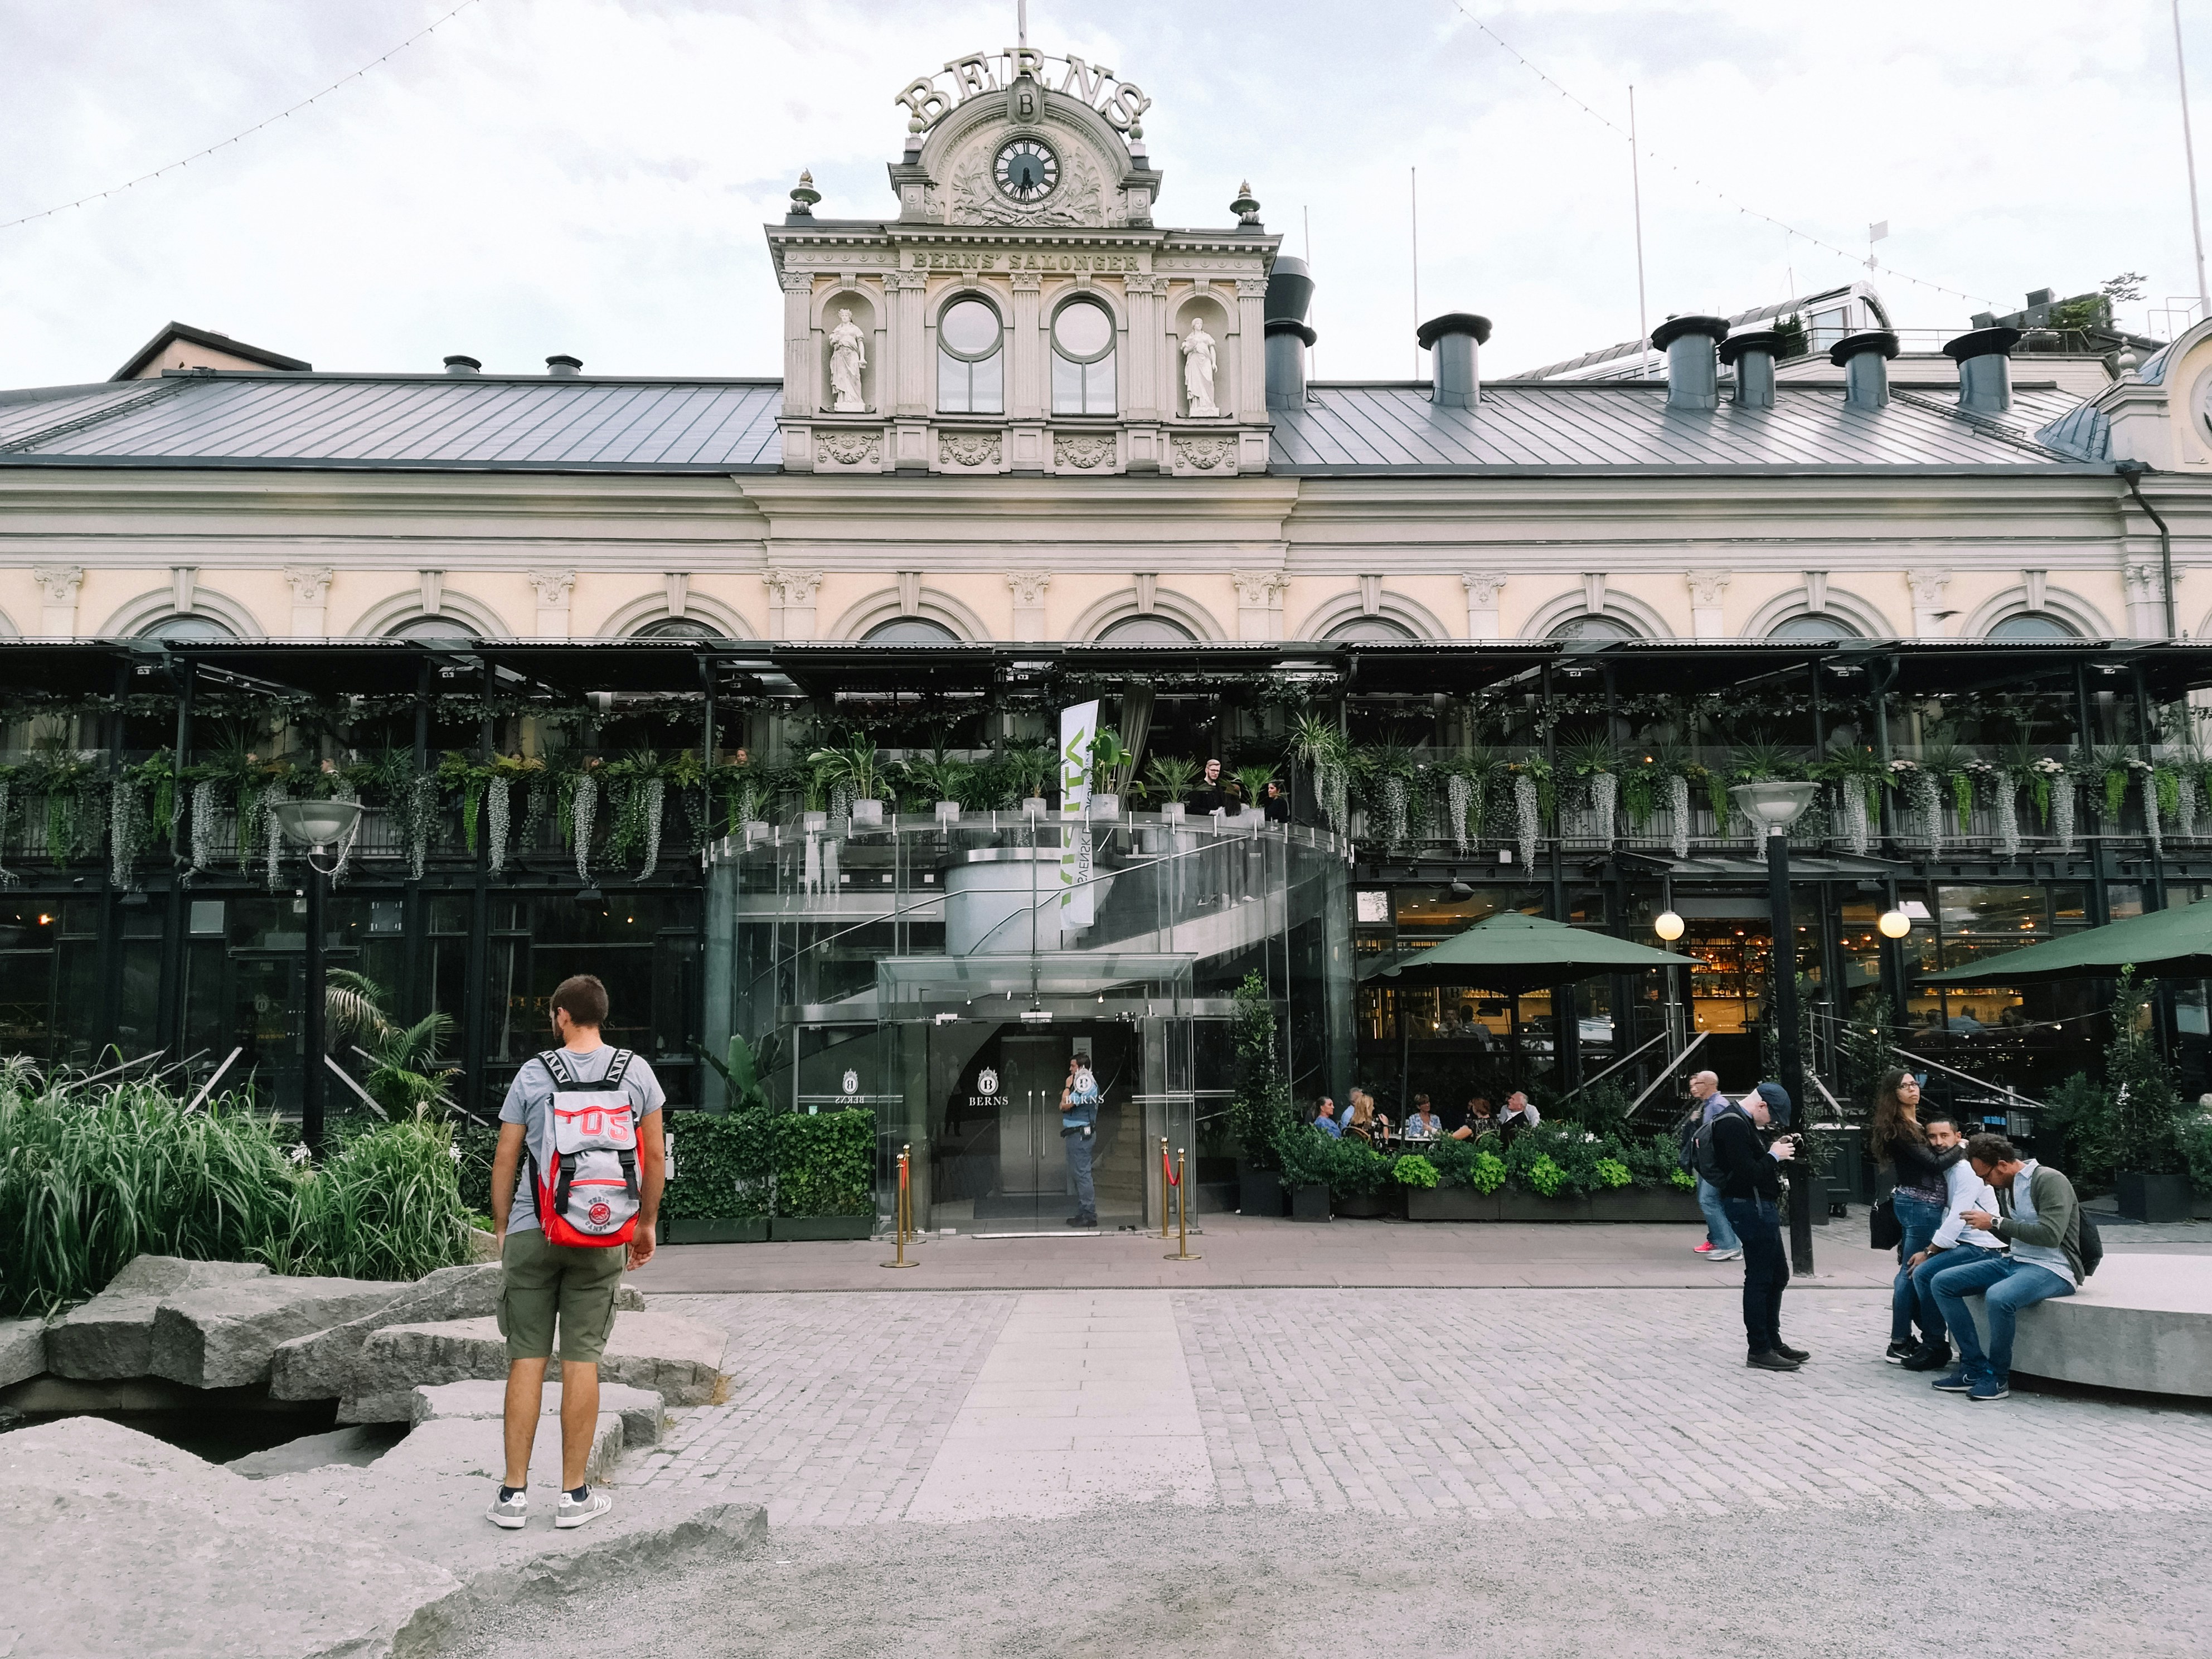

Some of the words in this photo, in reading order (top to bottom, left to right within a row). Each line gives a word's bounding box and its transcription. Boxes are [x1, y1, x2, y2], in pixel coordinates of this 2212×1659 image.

[894, 47, 1152, 133] BERNS
[1019, 94, 1034, 115] B
[1008, 254, 1139, 271] SALONGER
[984, 1079, 993, 1090] B
[1080, 1078, 1088, 1088] B
[969, 1096, 1008, 1106] BERNS
[1065, 1094, 1104, 1104] BERNS
[580, 1111, 630, 1142] 05
